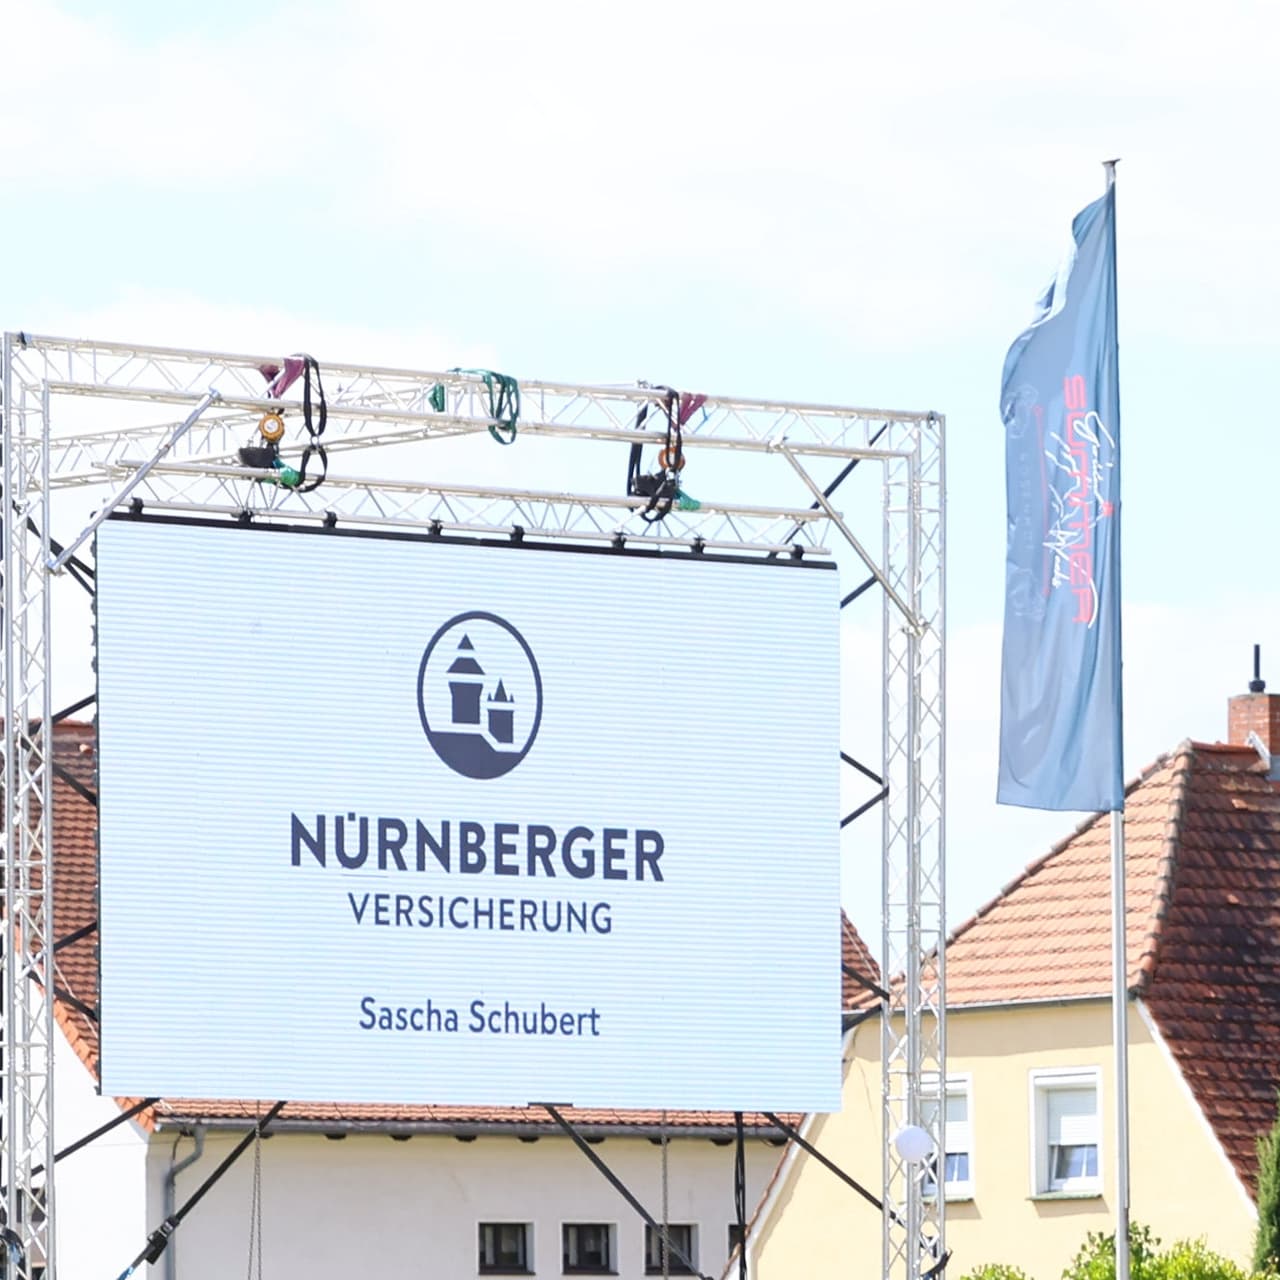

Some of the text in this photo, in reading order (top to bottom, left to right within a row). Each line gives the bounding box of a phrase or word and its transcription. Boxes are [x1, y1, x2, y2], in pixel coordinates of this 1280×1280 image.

[290, 811, 665, 883] NÜRNBERGER
[347, 891, 613, 935] VERSICHERUNG
[358, 996, 601, 1037] Sascha Schubert
